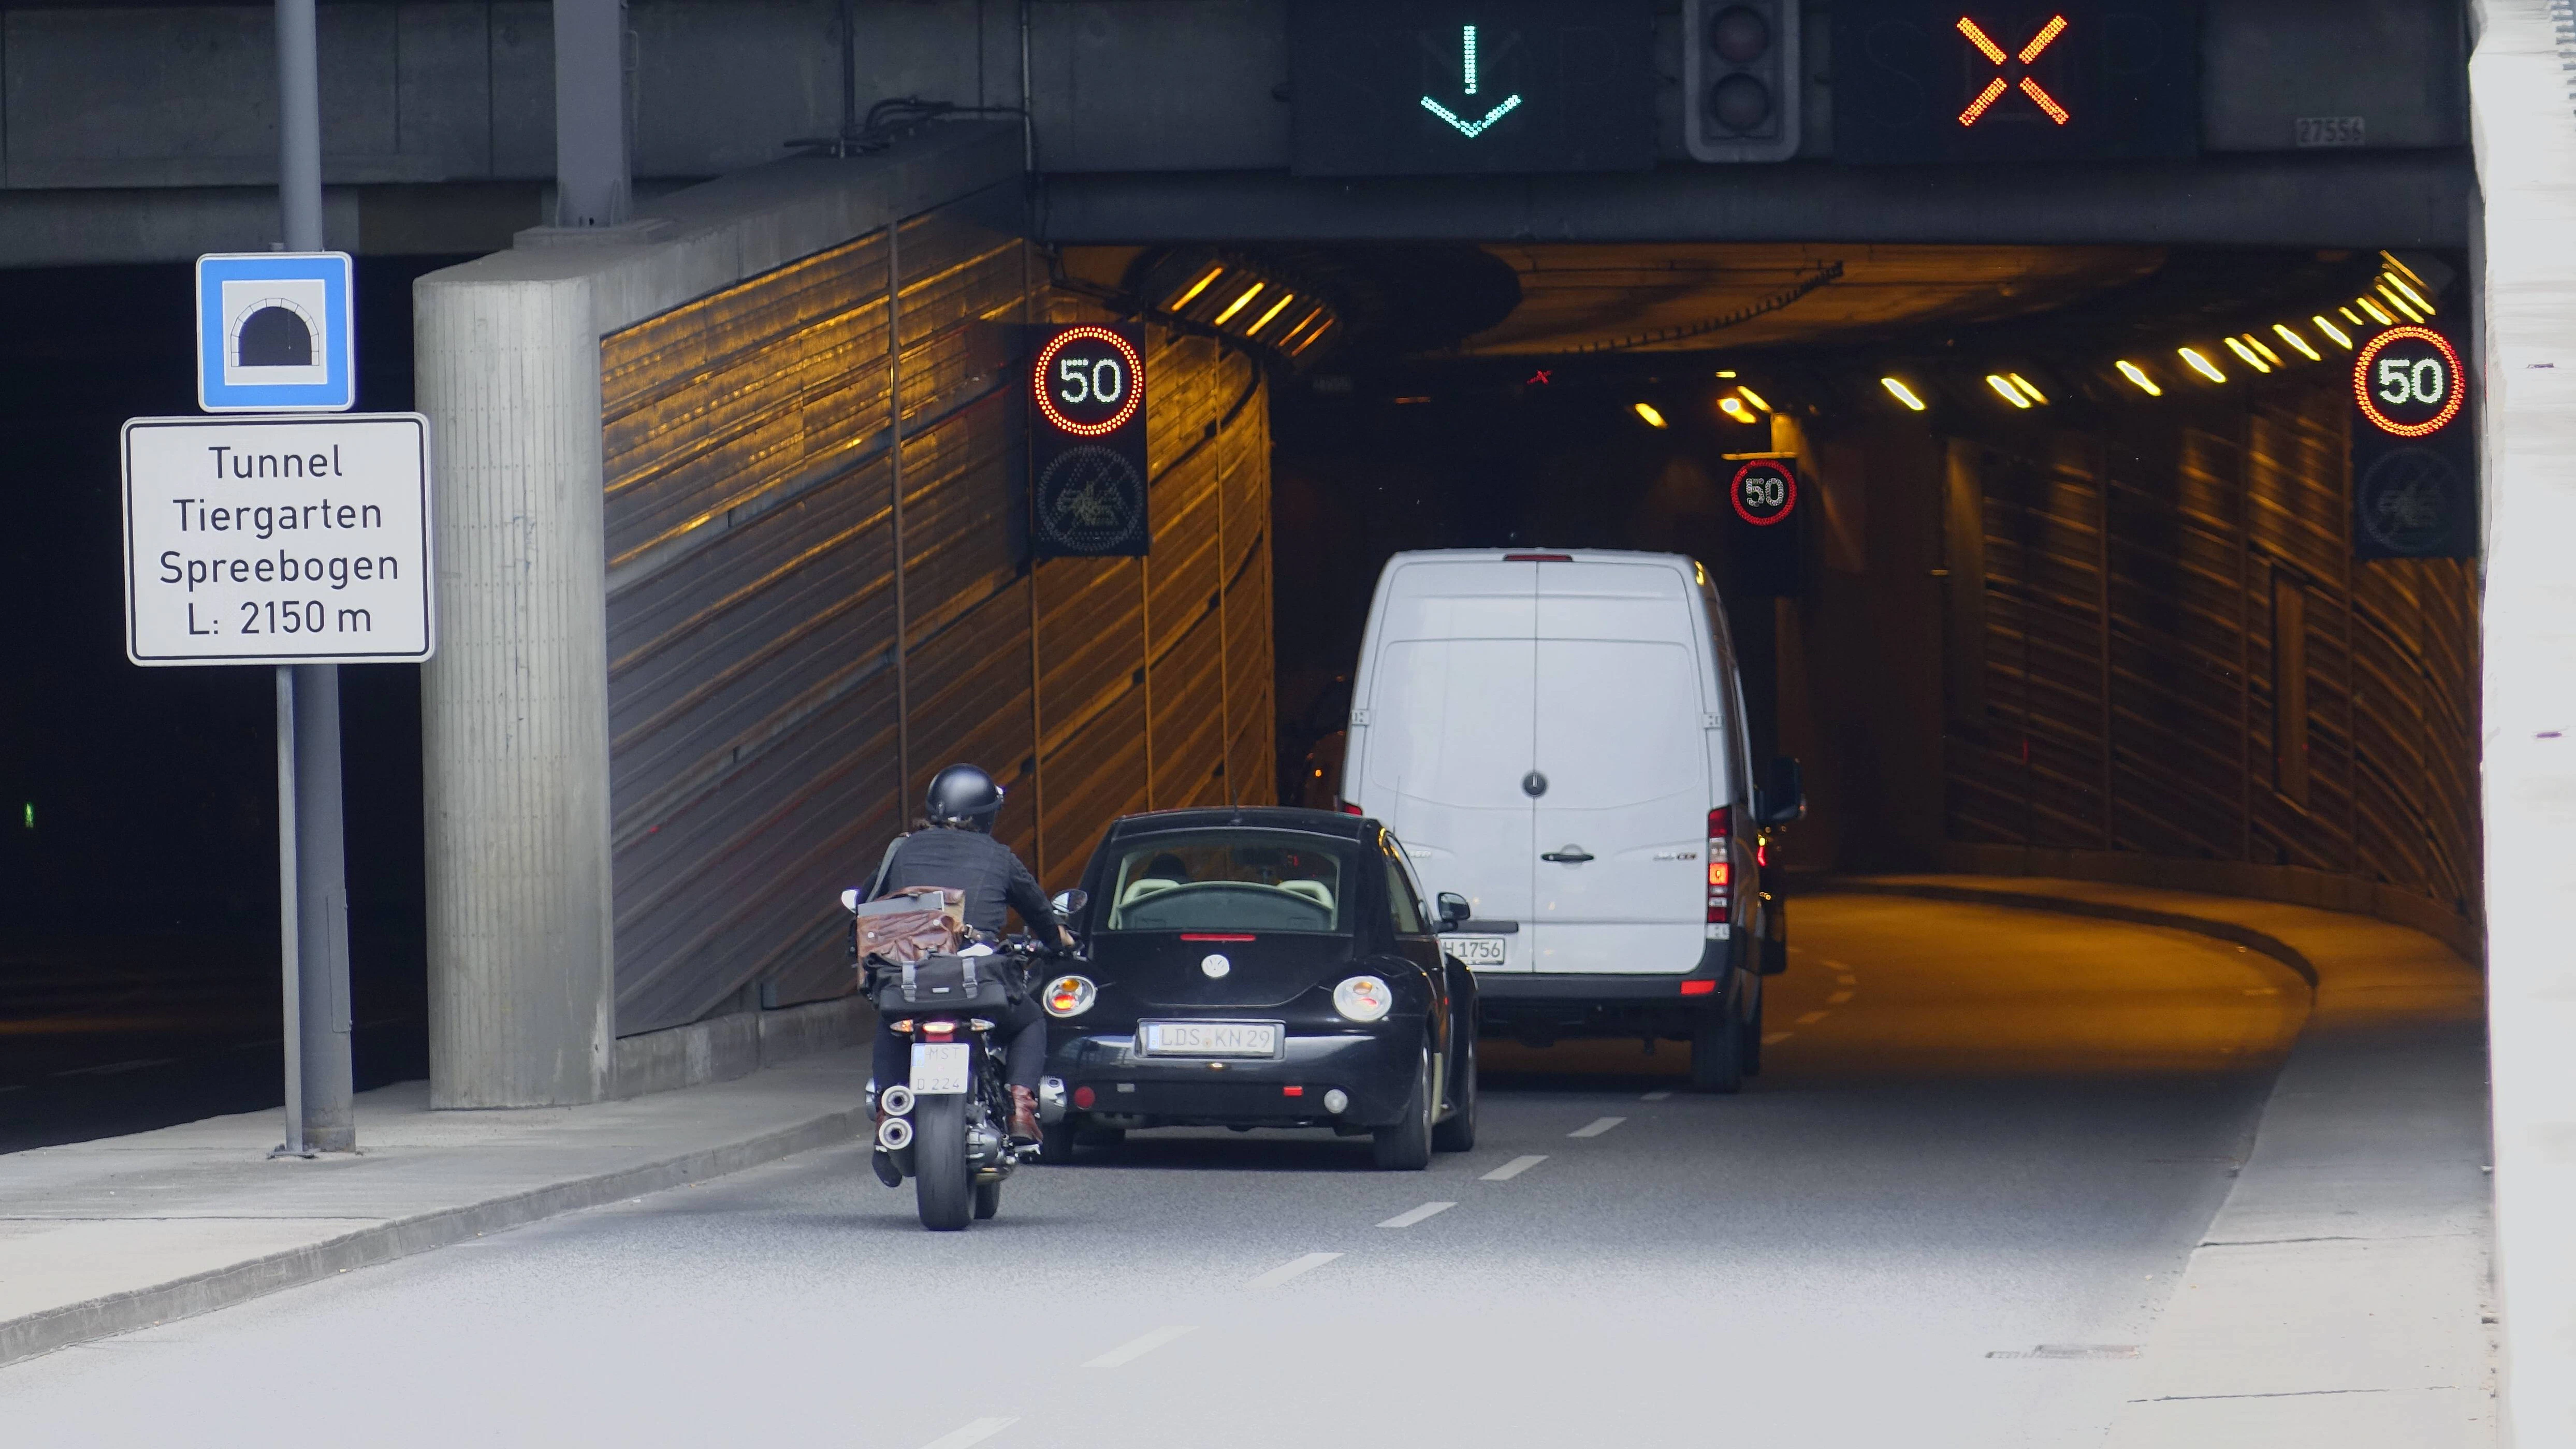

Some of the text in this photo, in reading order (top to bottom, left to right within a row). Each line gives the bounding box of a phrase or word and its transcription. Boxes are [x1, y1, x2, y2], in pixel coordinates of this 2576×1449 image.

[1061, 359, 1121, 403] 50
[2380, 358, 2443, 403] 50
[208, 444, 342, 479] Tunnel
[1745, 477, 1784, 507] 50
[172, 498, 382, 540] Tiergarten
[159, 549, 399, 592] Spreebogen
[188, 600, 371, 634] L: 2150 m
[1459, 941, 1501, 958] 1756
[928, 1047, 960, 1060] MST
[1161, 1028, 1270, 1048] LDS KN 29
